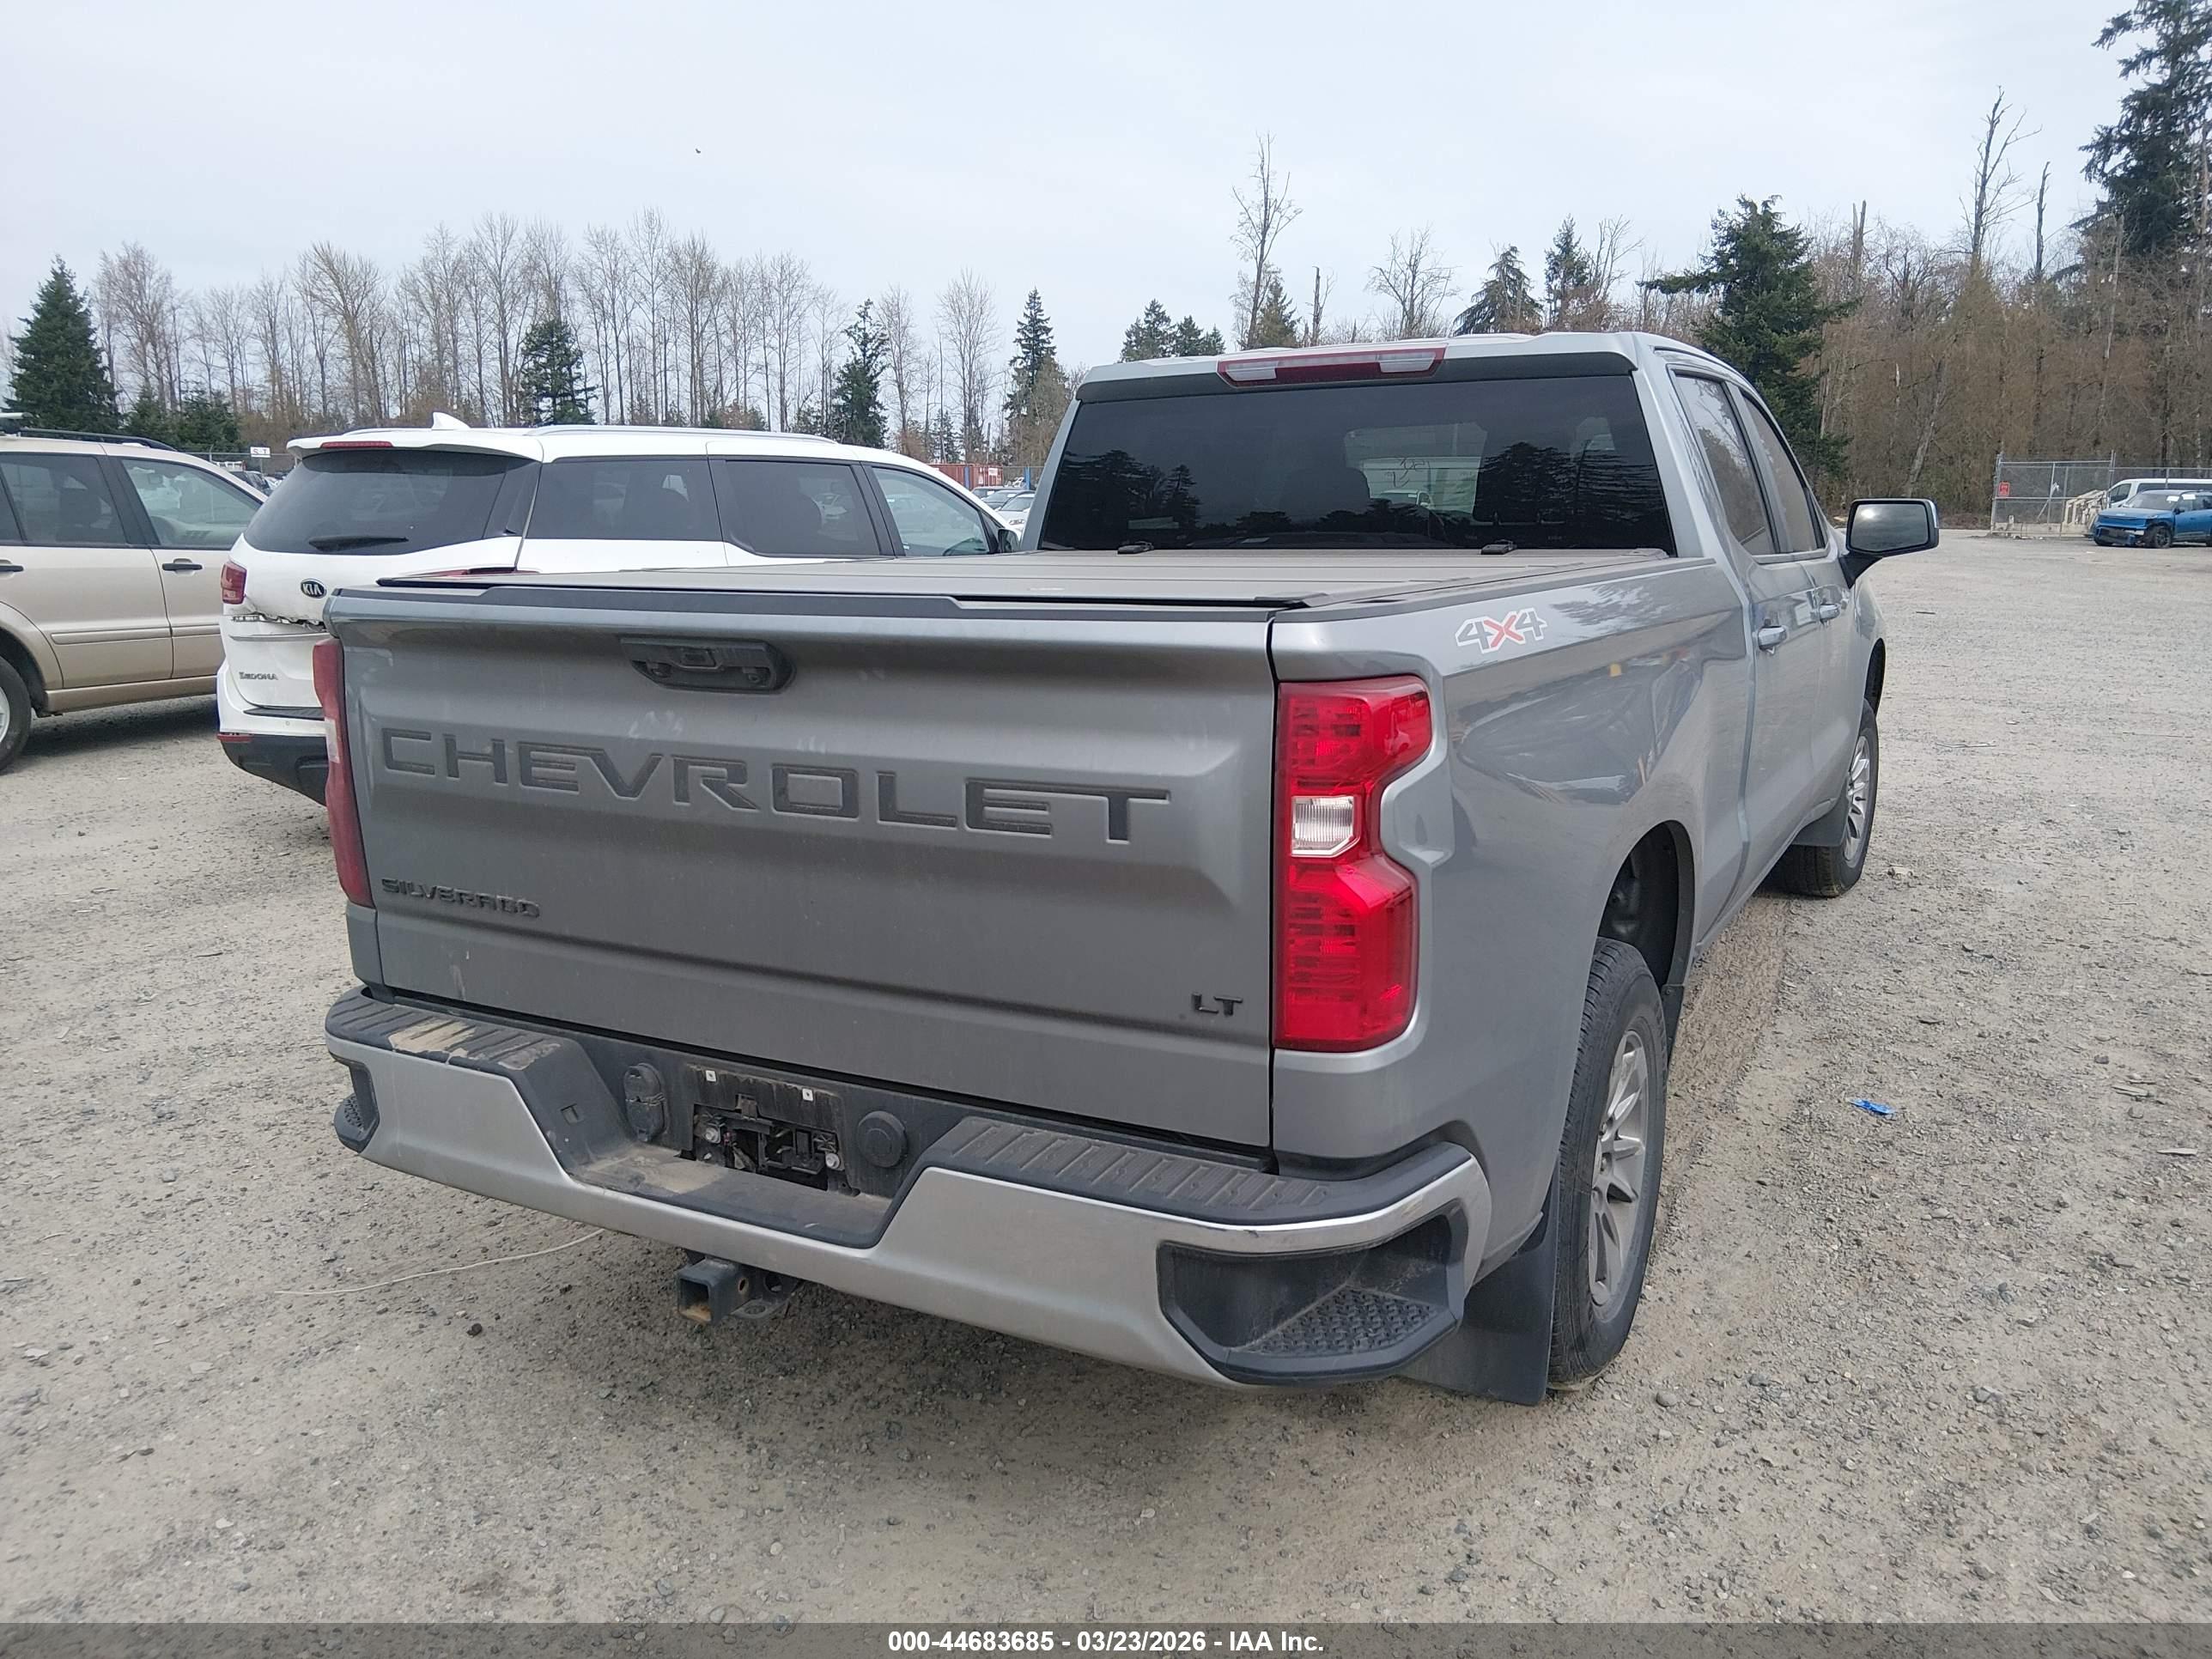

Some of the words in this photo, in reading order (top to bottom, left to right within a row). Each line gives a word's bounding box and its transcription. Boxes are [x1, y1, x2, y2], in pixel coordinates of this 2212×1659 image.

[302, 583, 324, 595] KIA
[381, 727, 1171, 844] CHEVROLET
[381, 878, 541, 918] SILVERADO
[1191, 993, 1243, 1017] LT
